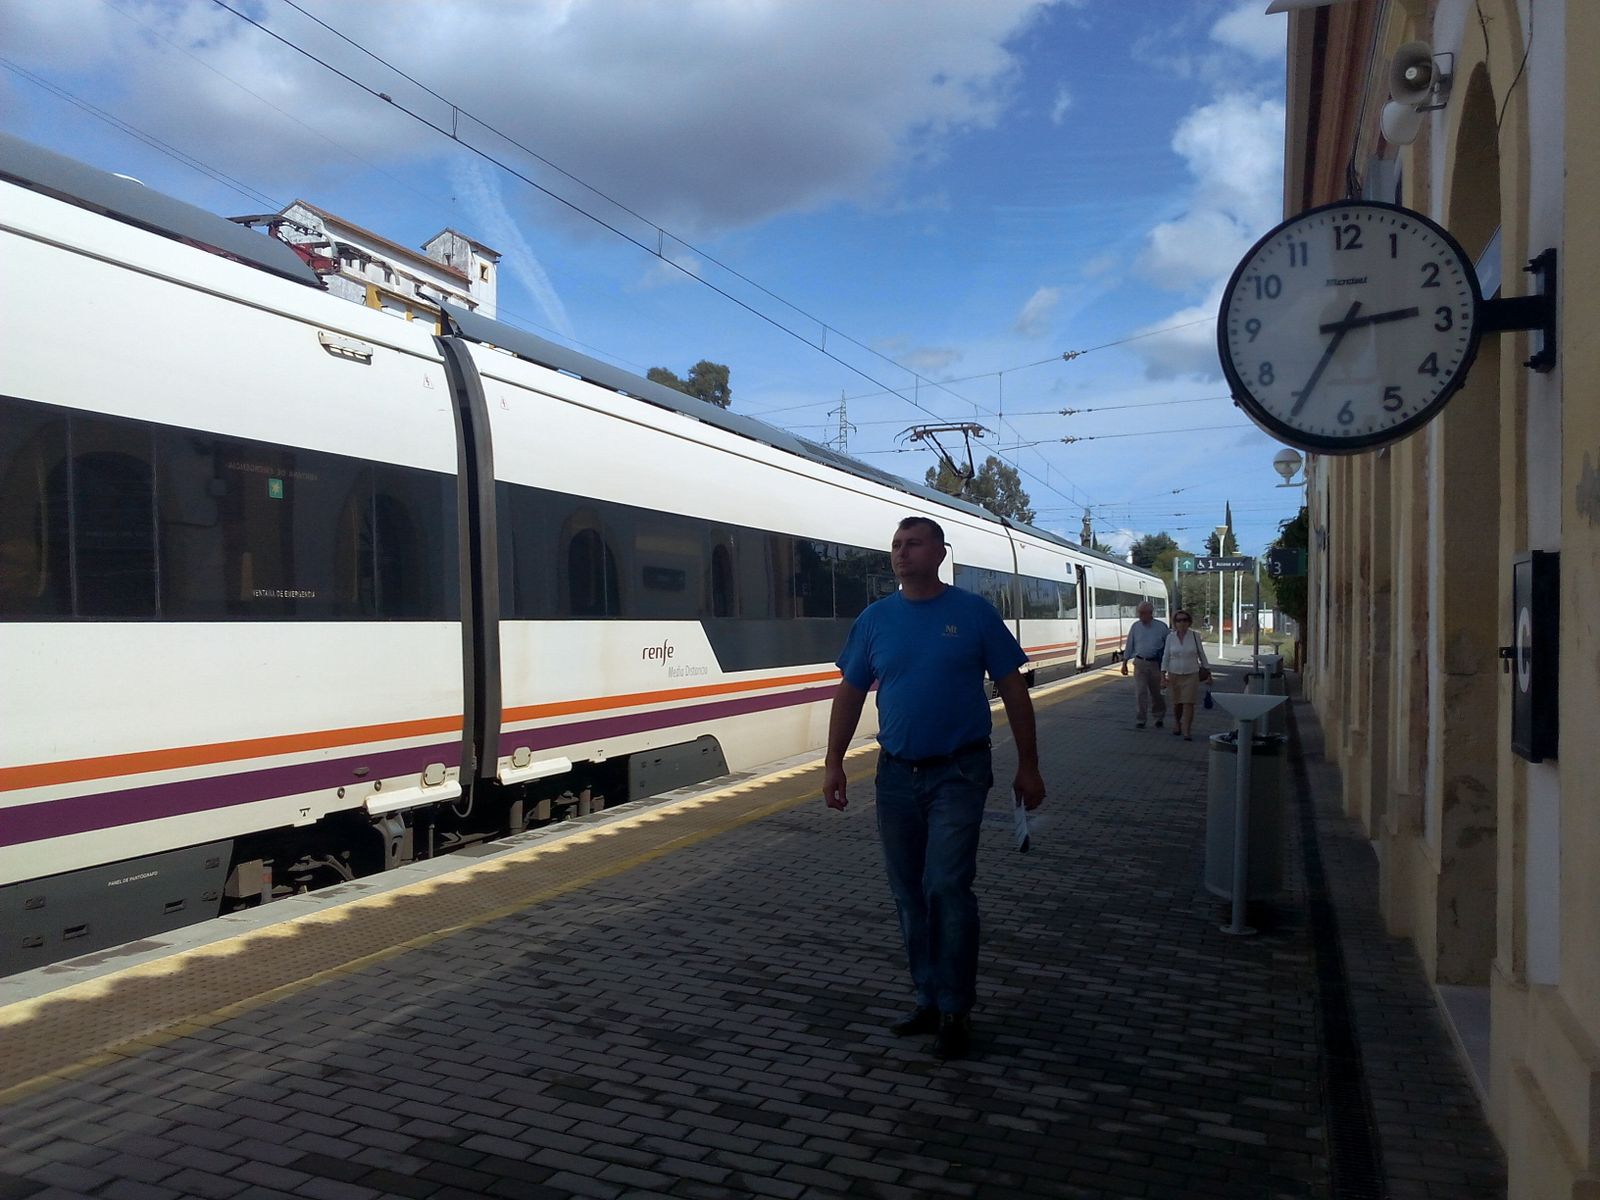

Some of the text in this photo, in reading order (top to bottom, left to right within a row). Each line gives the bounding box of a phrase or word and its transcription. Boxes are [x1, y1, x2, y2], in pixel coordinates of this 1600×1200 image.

[1333, 224, 1363, 250] 12
[1389, 233, 1397, 259] 1
[1288, 241, 1308, 267] 11
[1254, 274, 1282, 300] 10
[1421, 262, 1441, 288] 2
[1245, 318, 1262, 343] 9
[1434, 306, 1453, 332] 3
[1258, 361, 1275, 387] 8
[1417, 352, 1439, 377] 4
[1382, 386, 1403, 412] 5
[1337, 401, 1354, 425] 6
[1208, 559, 1214, 569] 1
[1273, 561, 1282, 575] 3
[642, 639, 674, 666] renfe
